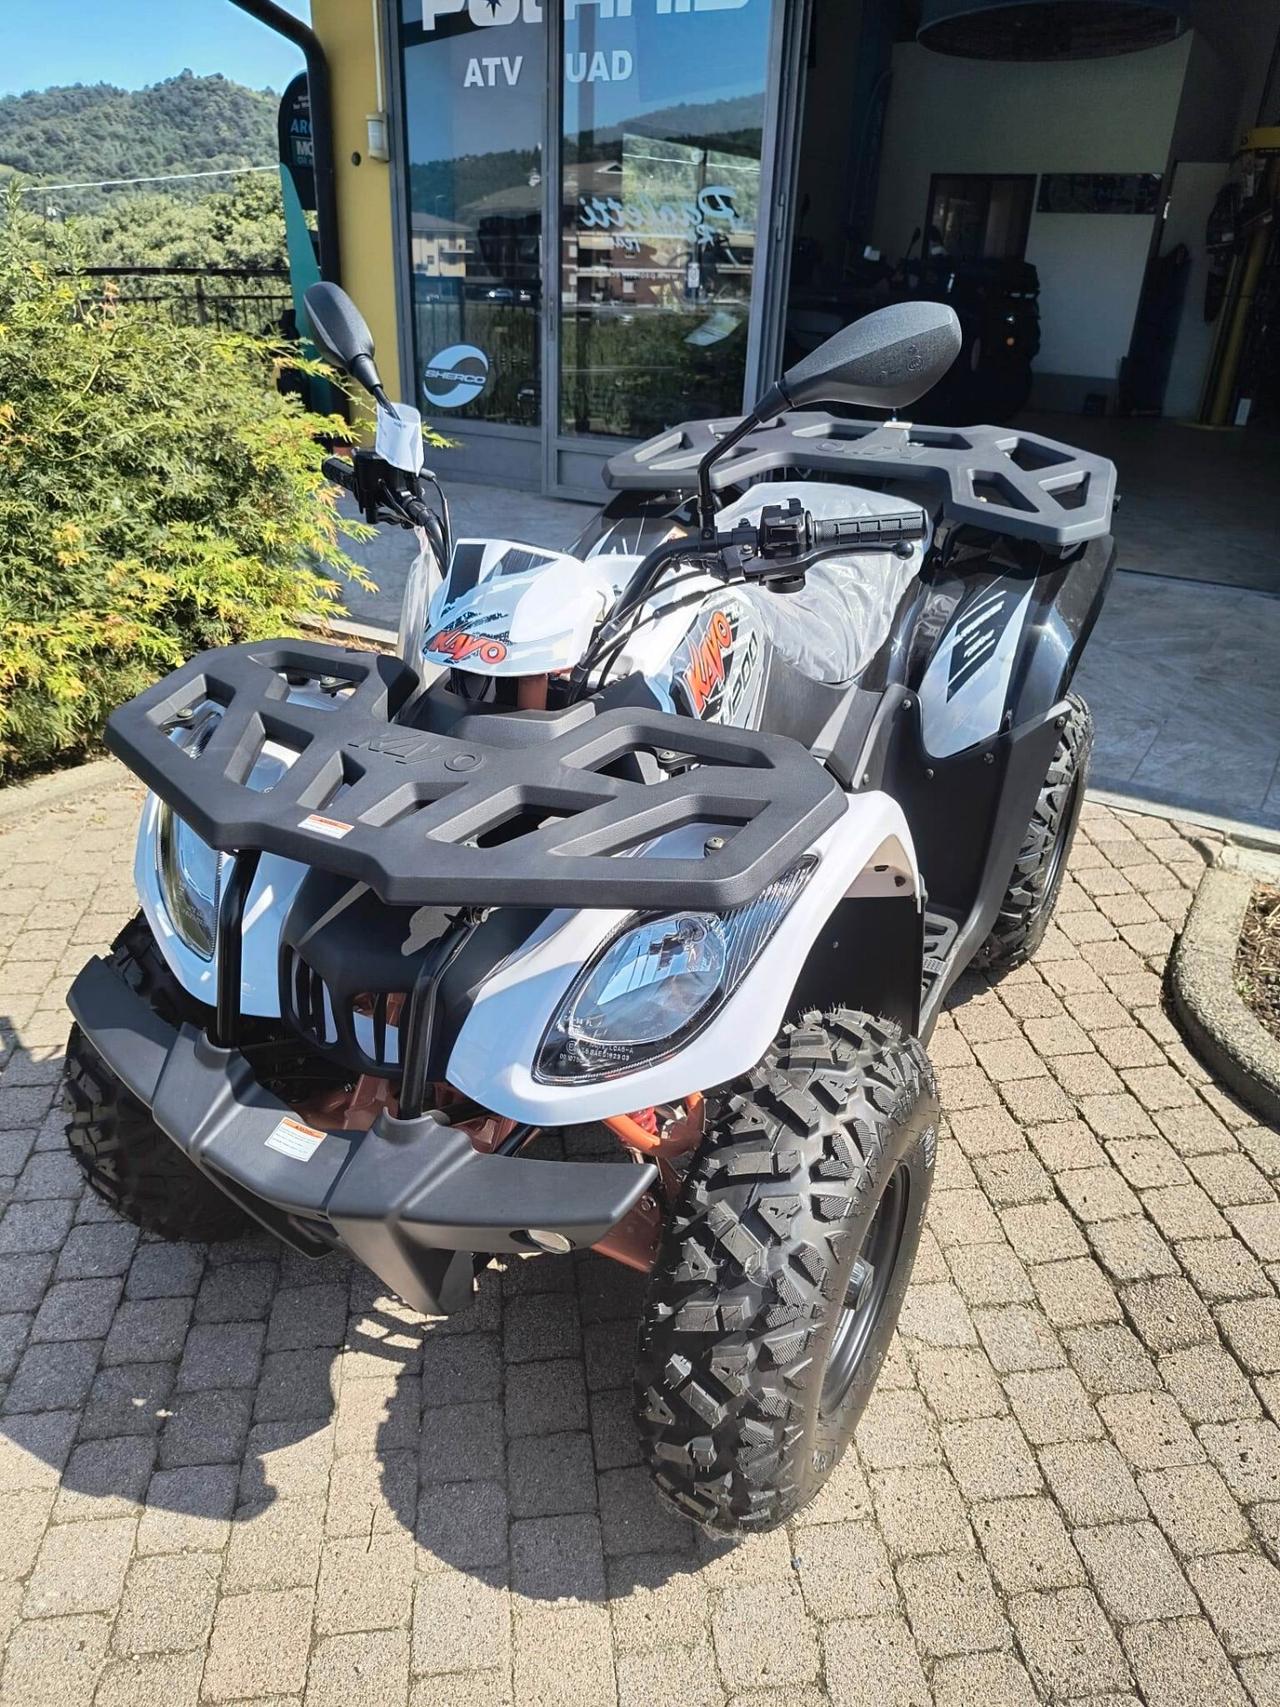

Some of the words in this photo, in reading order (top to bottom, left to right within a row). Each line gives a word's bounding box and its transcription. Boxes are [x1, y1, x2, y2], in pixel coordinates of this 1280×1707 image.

[464, 56, 523, 88] ATV
[424, 369, 487, 385] SHERCO
[424, 622, 508, 665] KAYO
[682, 609, 733, 716] KAYO
[346, 732, 484, 774] KAYO
